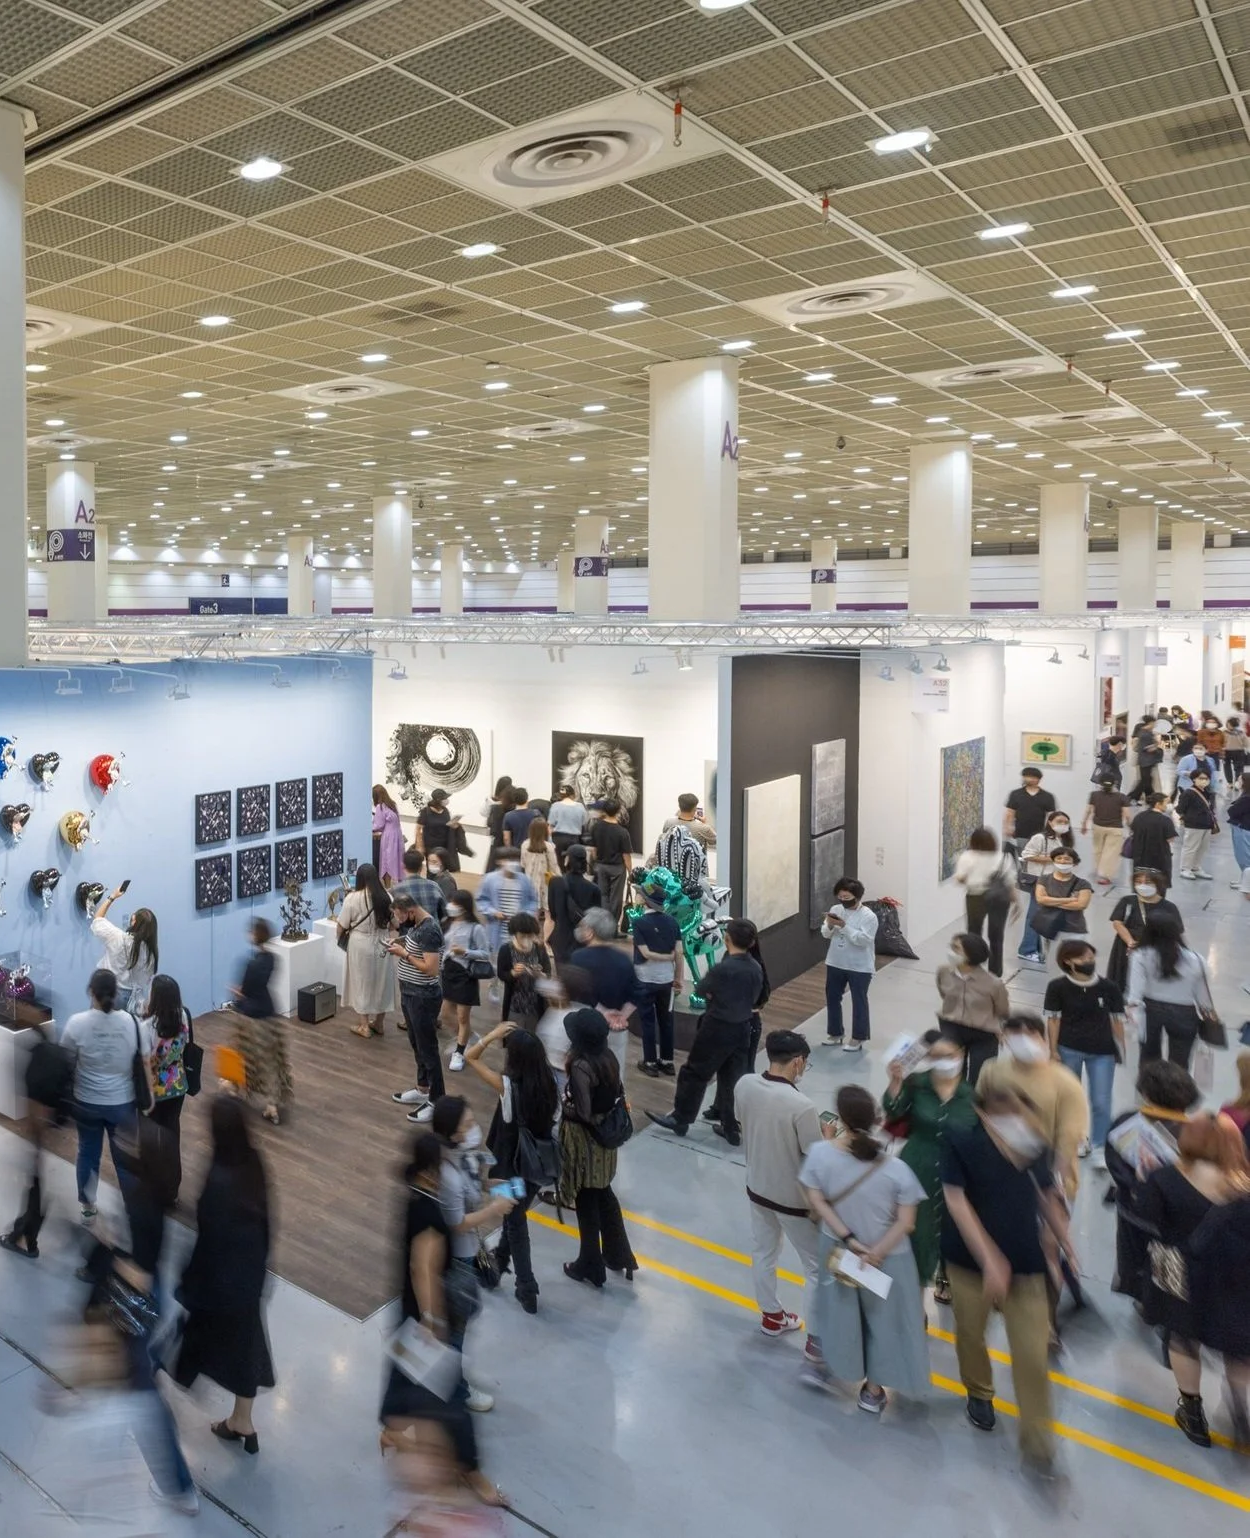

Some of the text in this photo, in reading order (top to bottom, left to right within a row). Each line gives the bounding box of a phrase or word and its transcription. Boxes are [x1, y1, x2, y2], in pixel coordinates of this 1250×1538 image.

[75, 499, 95, 524] A2
[199, 602, 219, 614] Gate 3
